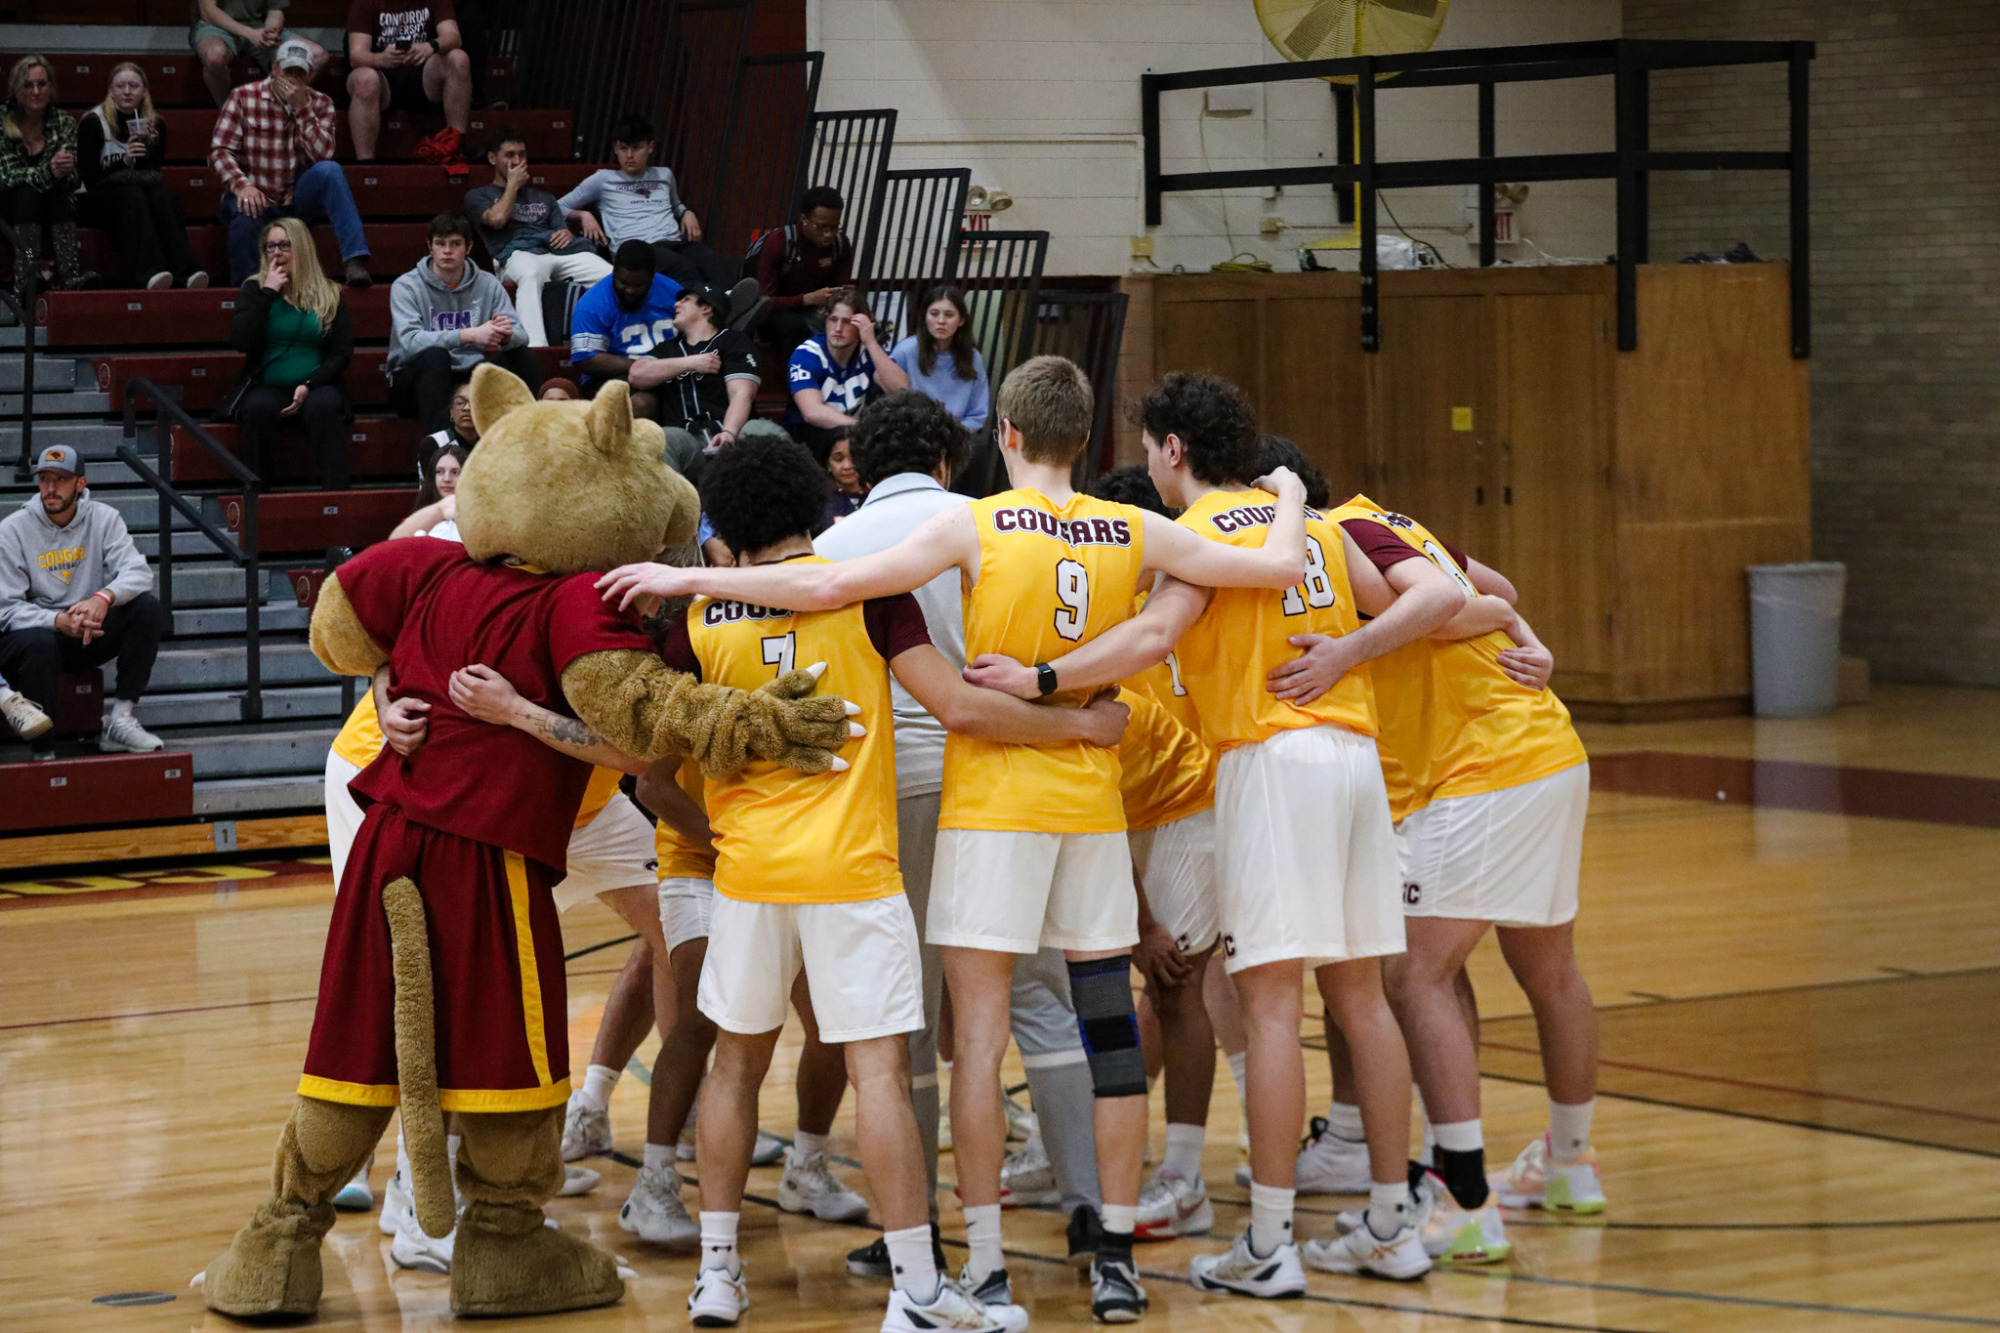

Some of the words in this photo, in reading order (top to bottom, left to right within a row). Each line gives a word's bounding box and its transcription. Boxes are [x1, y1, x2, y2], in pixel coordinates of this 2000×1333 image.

[992, 506, 1131, 548] COUGARS
[1054, 558, 1089, 642] 9
[761, 631, 796, 678] 7
